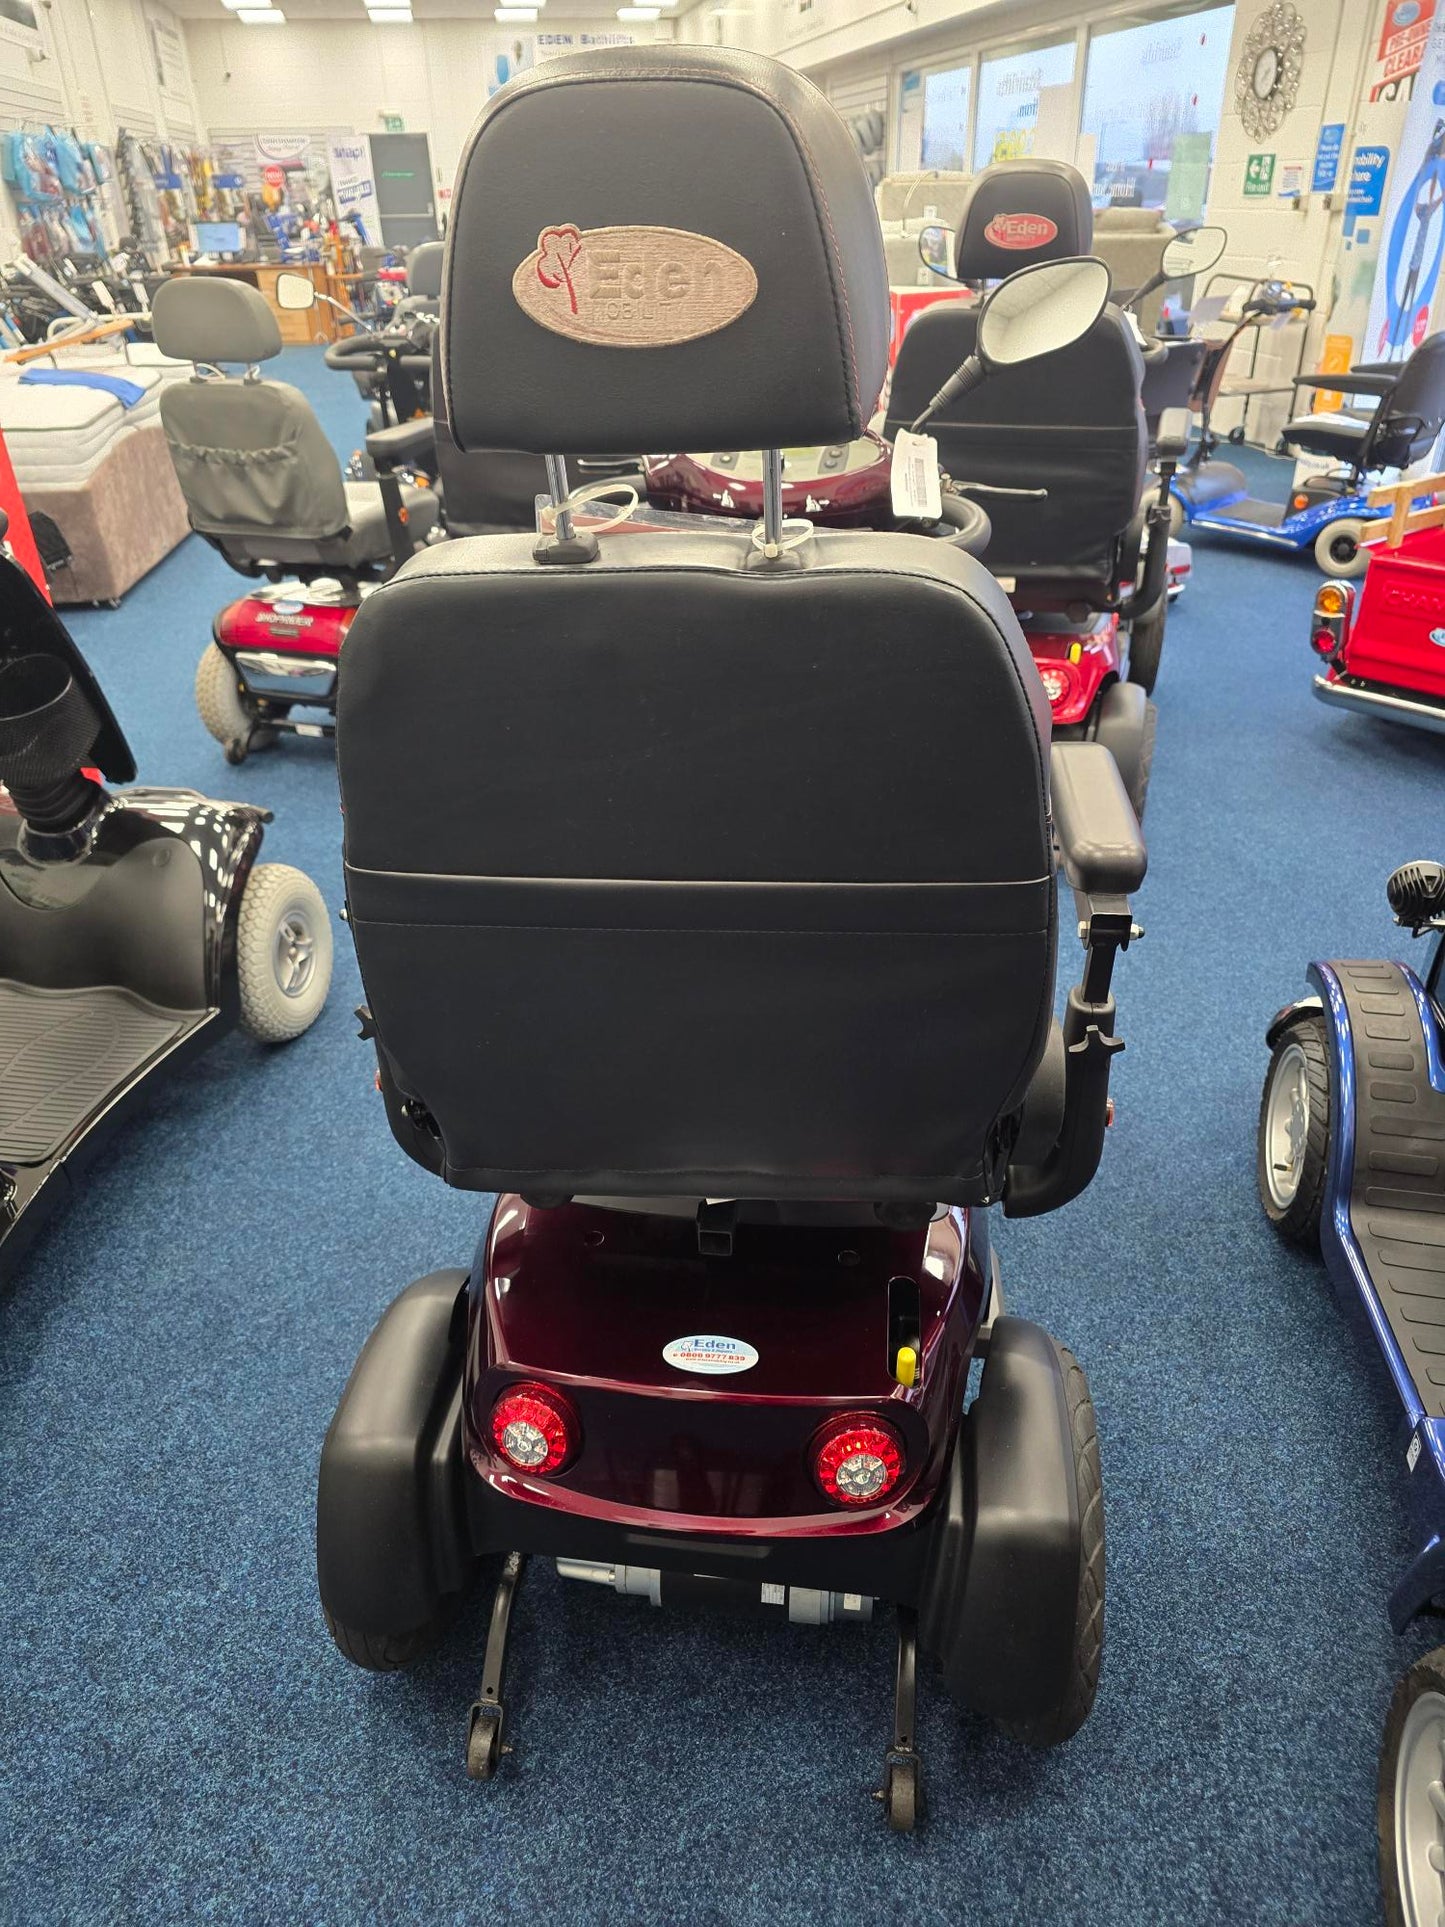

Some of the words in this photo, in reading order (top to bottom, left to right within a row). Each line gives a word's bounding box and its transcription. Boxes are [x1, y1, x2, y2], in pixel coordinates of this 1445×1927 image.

[1006, 220, 1048, 235] Eden
[586, 249, 724, 300] Eden
[694, 1339, 736, 1350] Eden
